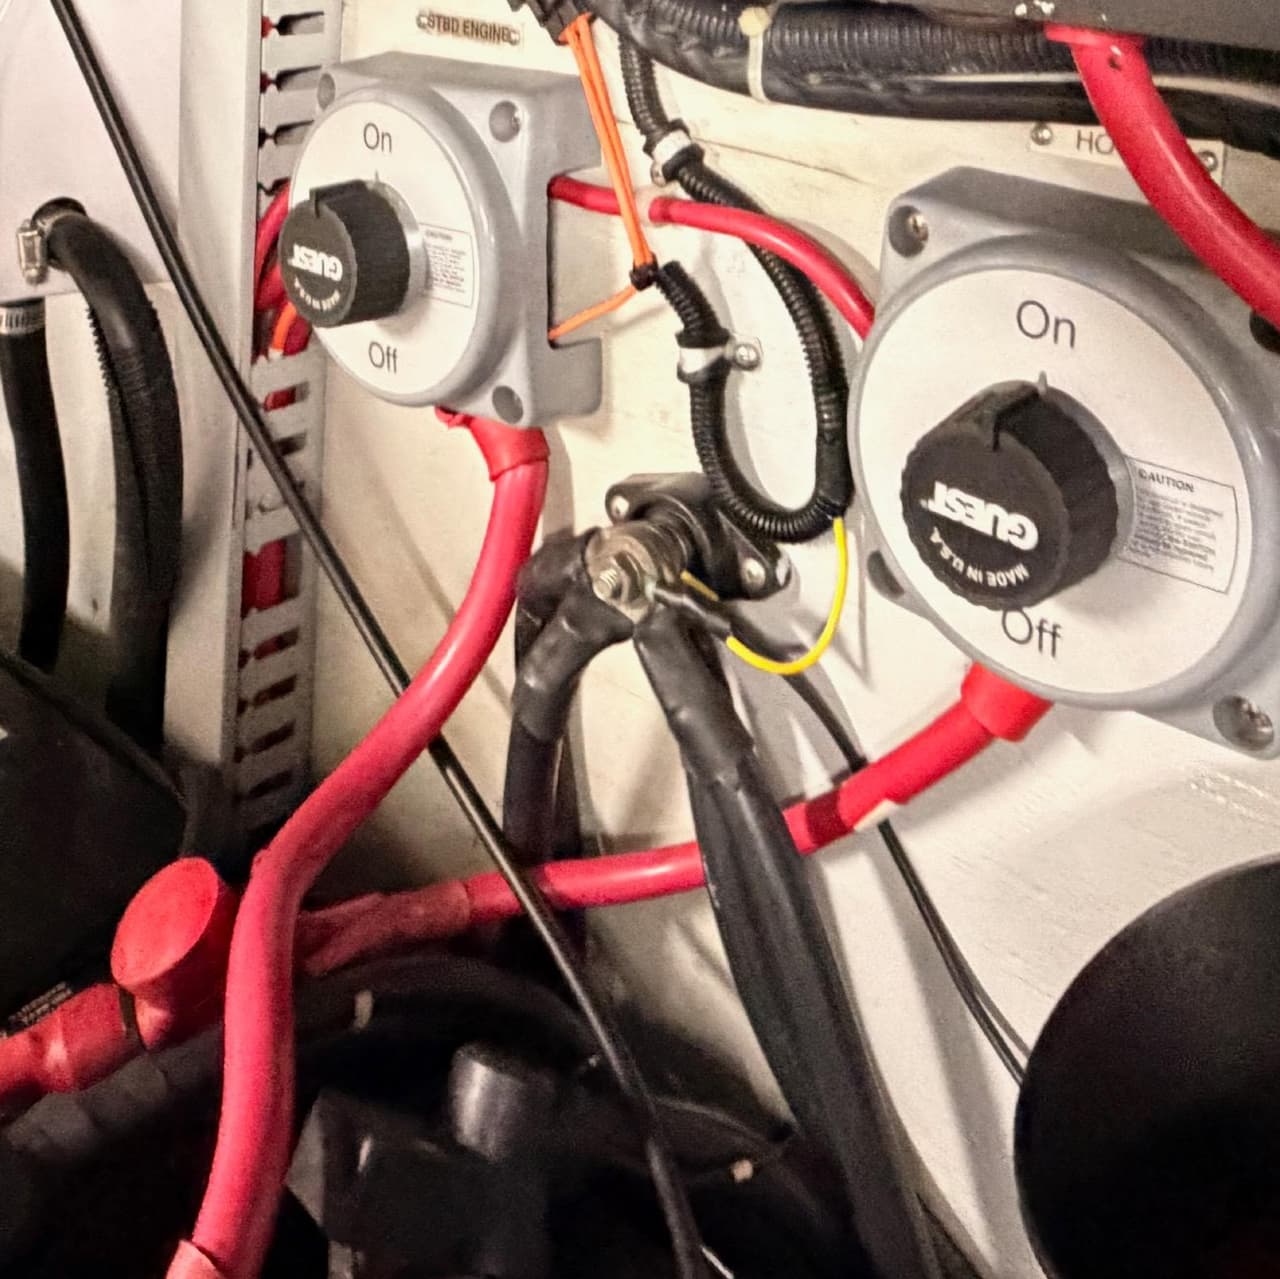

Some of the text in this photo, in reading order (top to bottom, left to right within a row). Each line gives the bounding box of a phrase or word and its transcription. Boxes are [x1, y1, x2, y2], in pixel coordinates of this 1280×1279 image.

[426, 12, 510, 45] STBD ENGINE
[362, 122, 393, 153] On
[1016, 299, 1076, 350] On
[368, 341, 398, 375] Off
[1137, 468, 1196, 493] CAUTION
[926, 480, 1039, 551] GUEST
[965, 565, 984, 585] IN
[985, 563, 1030, 588] MADE
[1001, 606, 1062, 659] Off
